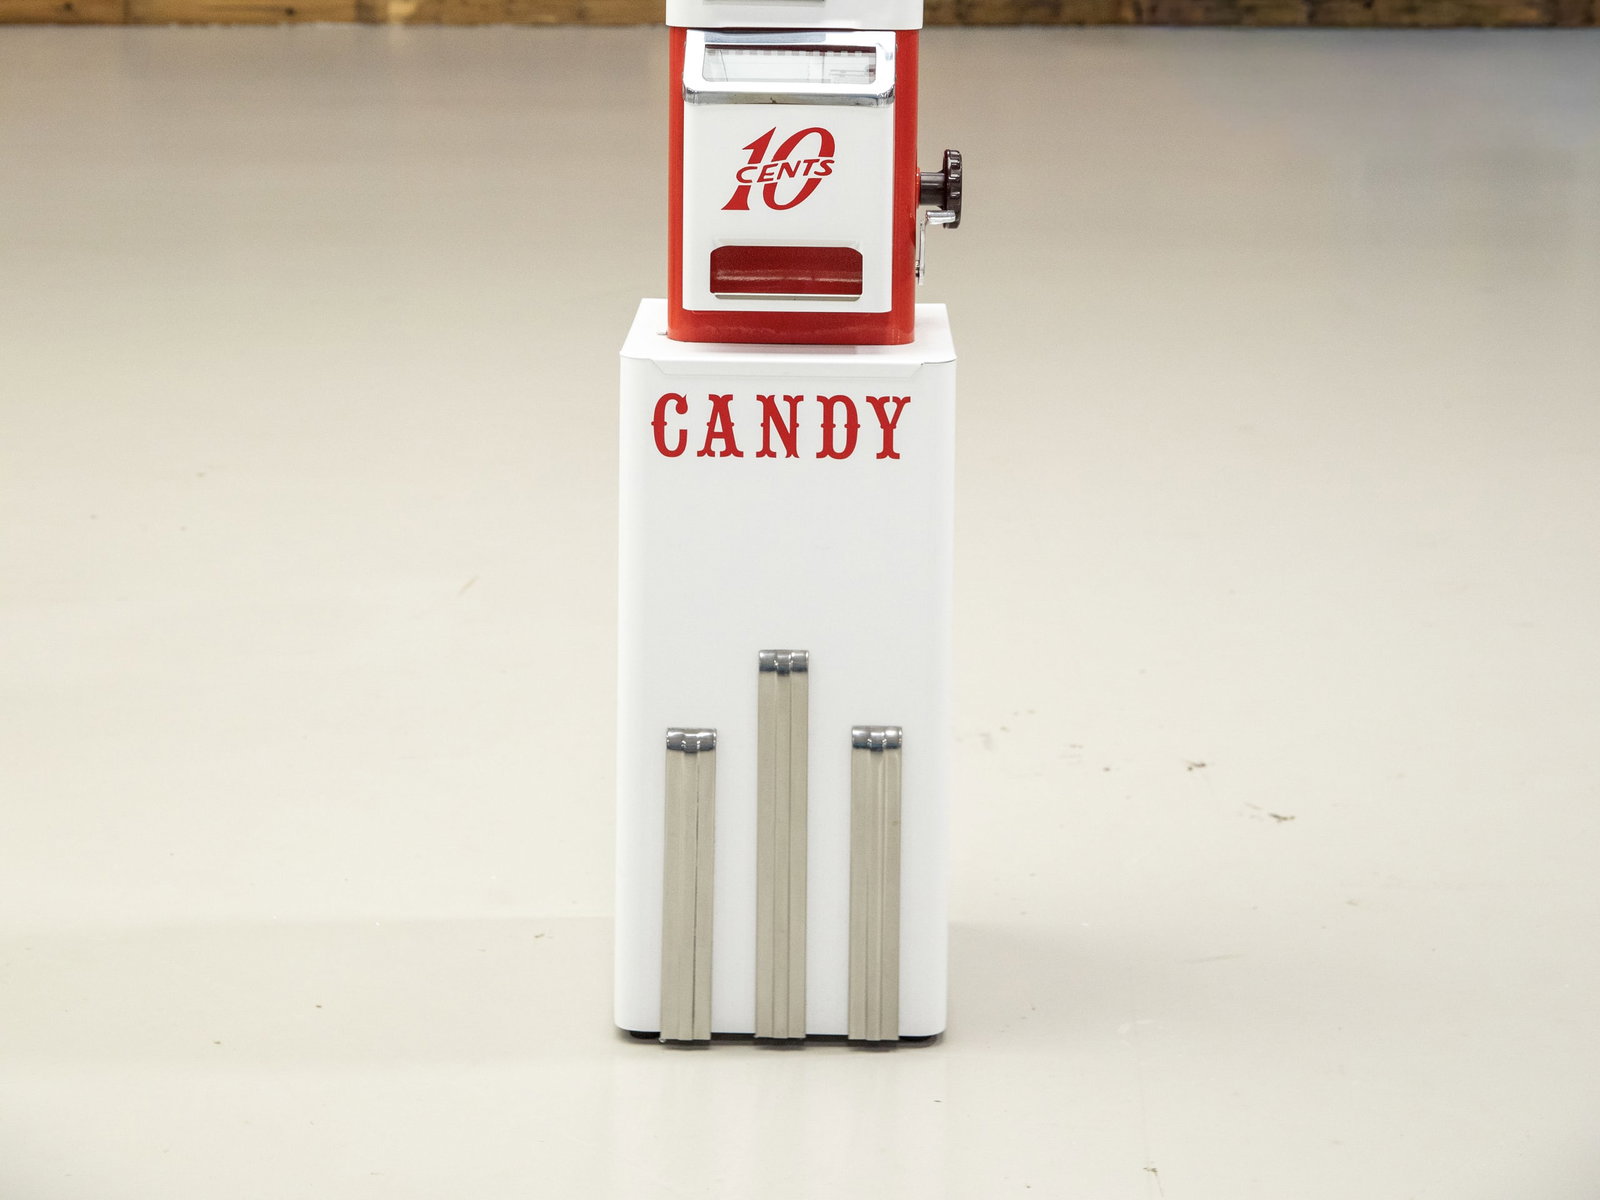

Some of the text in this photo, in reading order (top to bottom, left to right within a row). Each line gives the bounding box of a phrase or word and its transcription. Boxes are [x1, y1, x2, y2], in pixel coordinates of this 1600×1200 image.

[720, 126, 835, 210] 10
[736, 159, 835, 183] CENTS
[651, 393, 911, 460] CANDY
